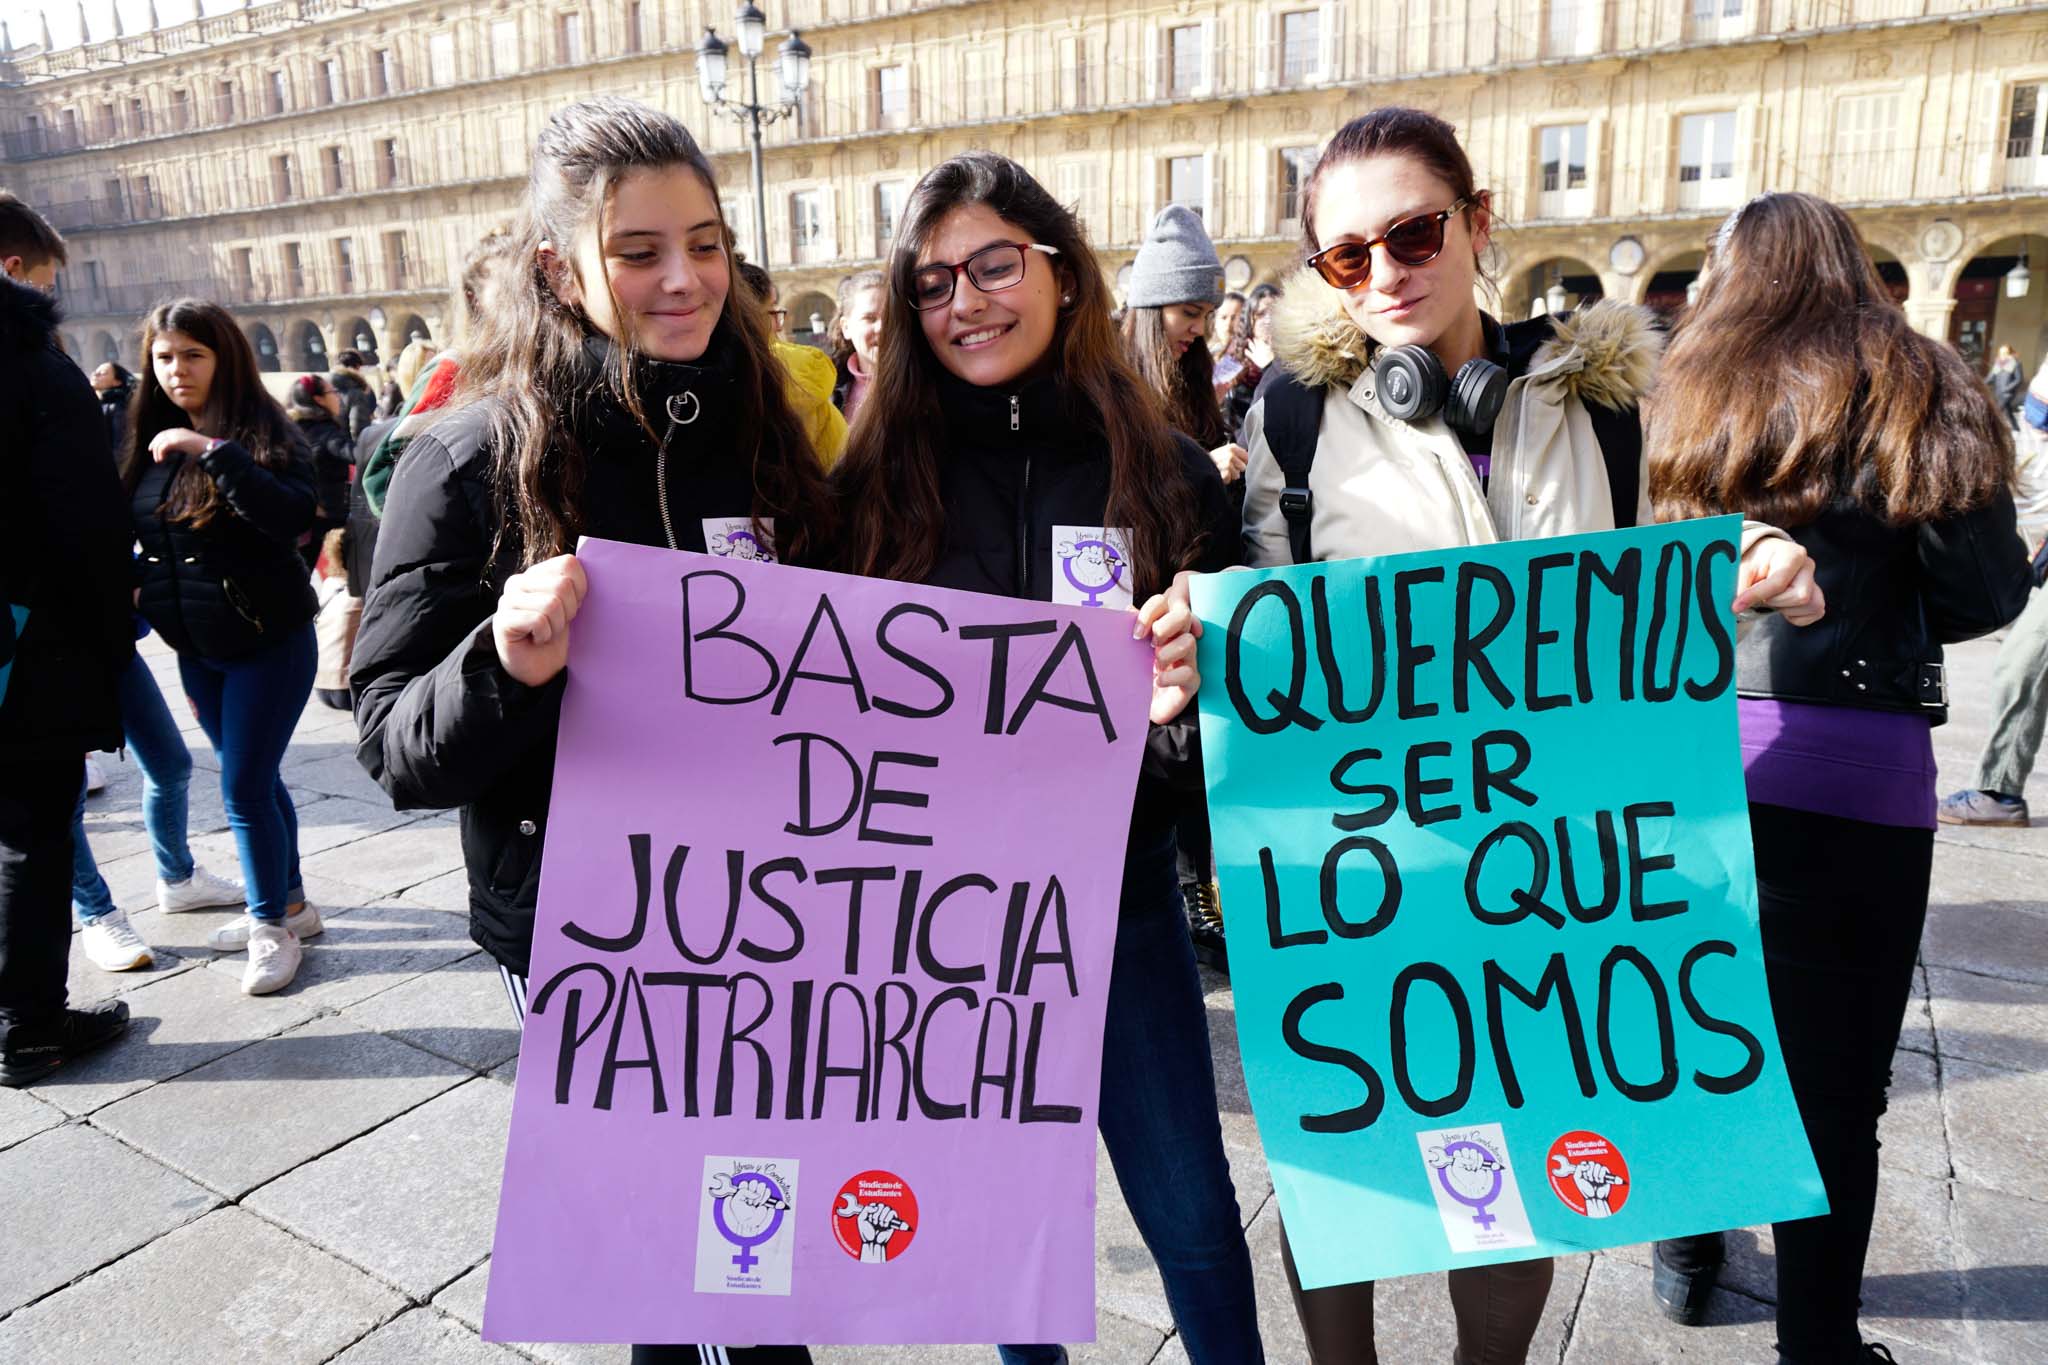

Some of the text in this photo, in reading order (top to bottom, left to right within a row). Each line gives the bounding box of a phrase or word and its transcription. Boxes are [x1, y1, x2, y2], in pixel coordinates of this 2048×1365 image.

[680, 569, 1118, 744] BASTA
[1223, 539, 1738, 736] QUEREMOS
[772, 732, 939, 847] DE
[1329, 729, 1539, 832] SER
[560, 833, 1079, 998] JUSTICIA
[1258, 800, 1690, 950] LO QUE
[530, 961, 1083, 1124] PATRIARCAL
[1281, 939, 1766, 1134] SOMOS
[858, 1188, 902, 1197] Estudiantes
